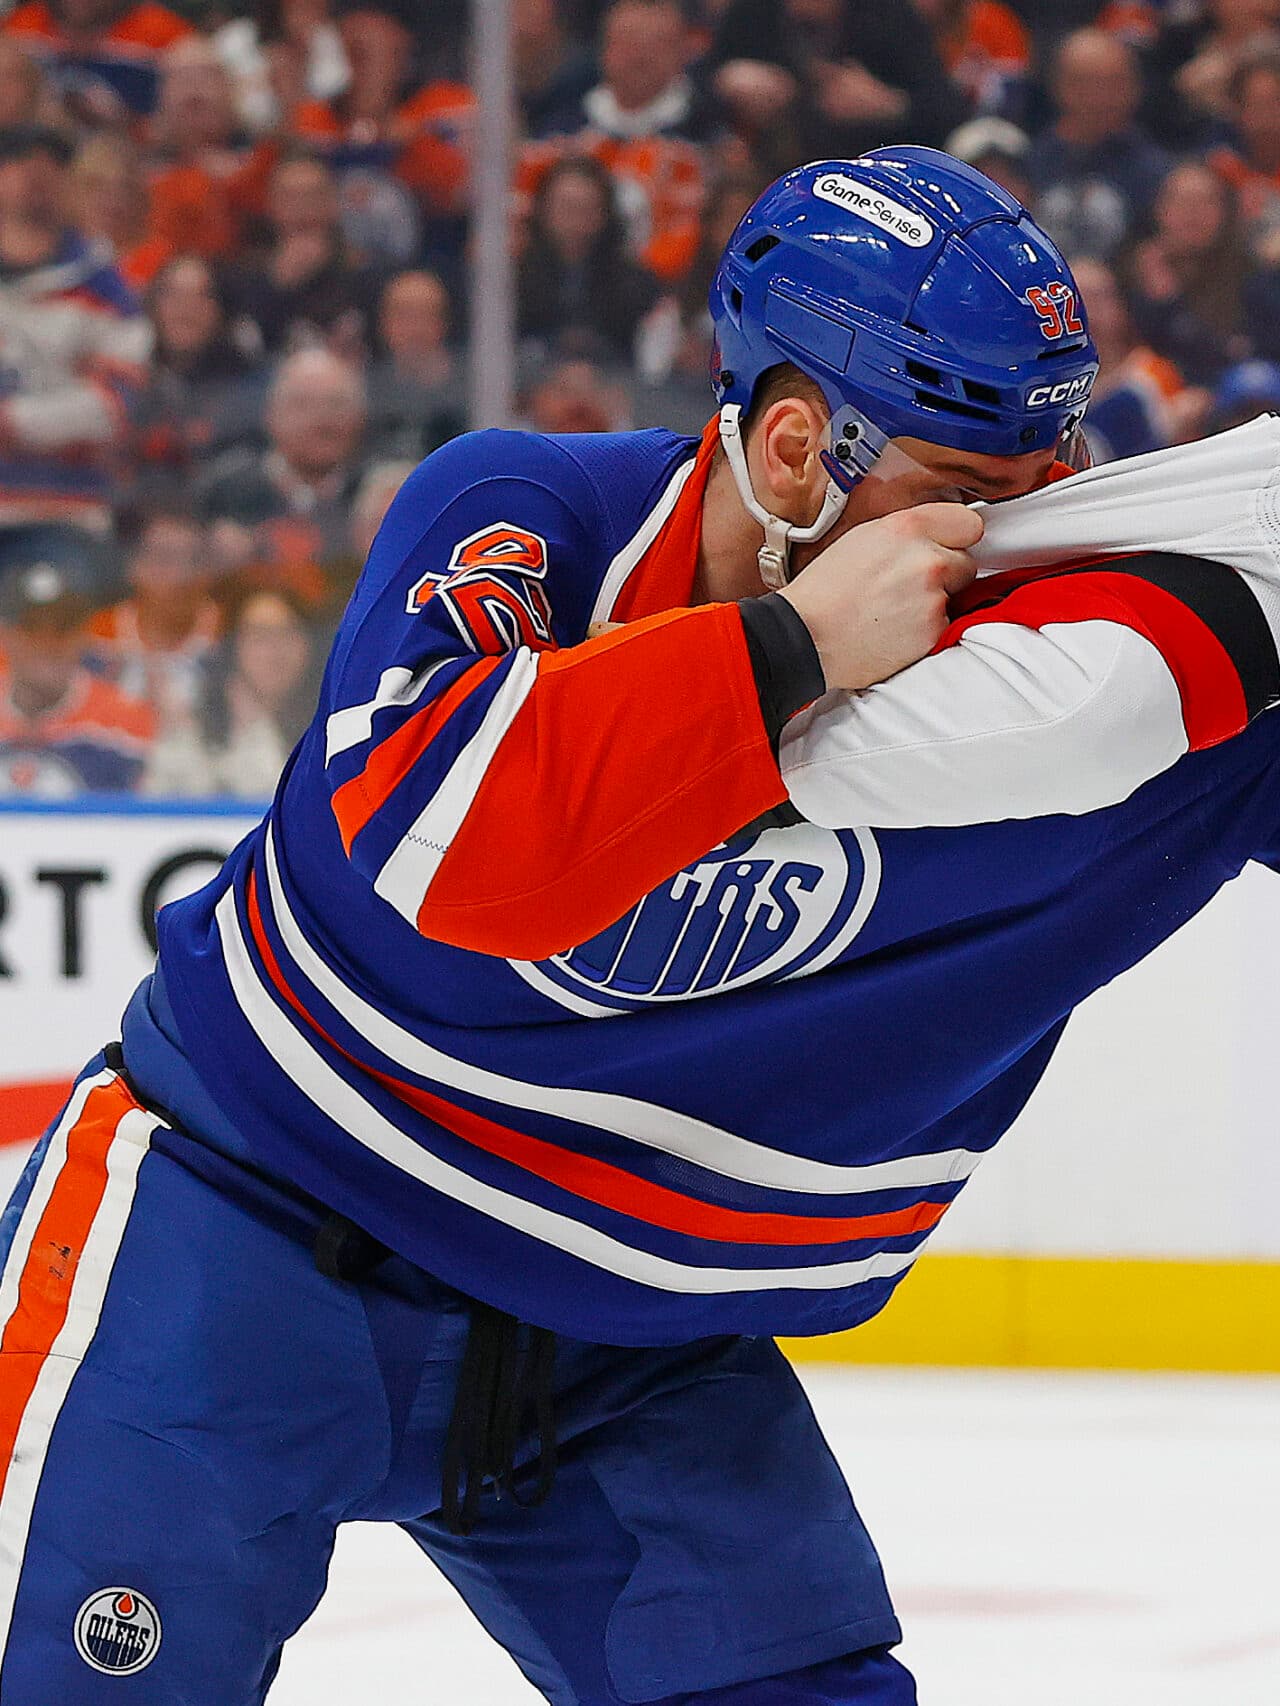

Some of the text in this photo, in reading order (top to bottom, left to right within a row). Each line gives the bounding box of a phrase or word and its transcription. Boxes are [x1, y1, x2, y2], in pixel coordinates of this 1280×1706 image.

[821, 178, 921, 242] GameSense
[1025, 281, 1084, 340] 92
[1027, 375, 1090, 407] CCM
[87, 1613, 151, 1658] OILERS
